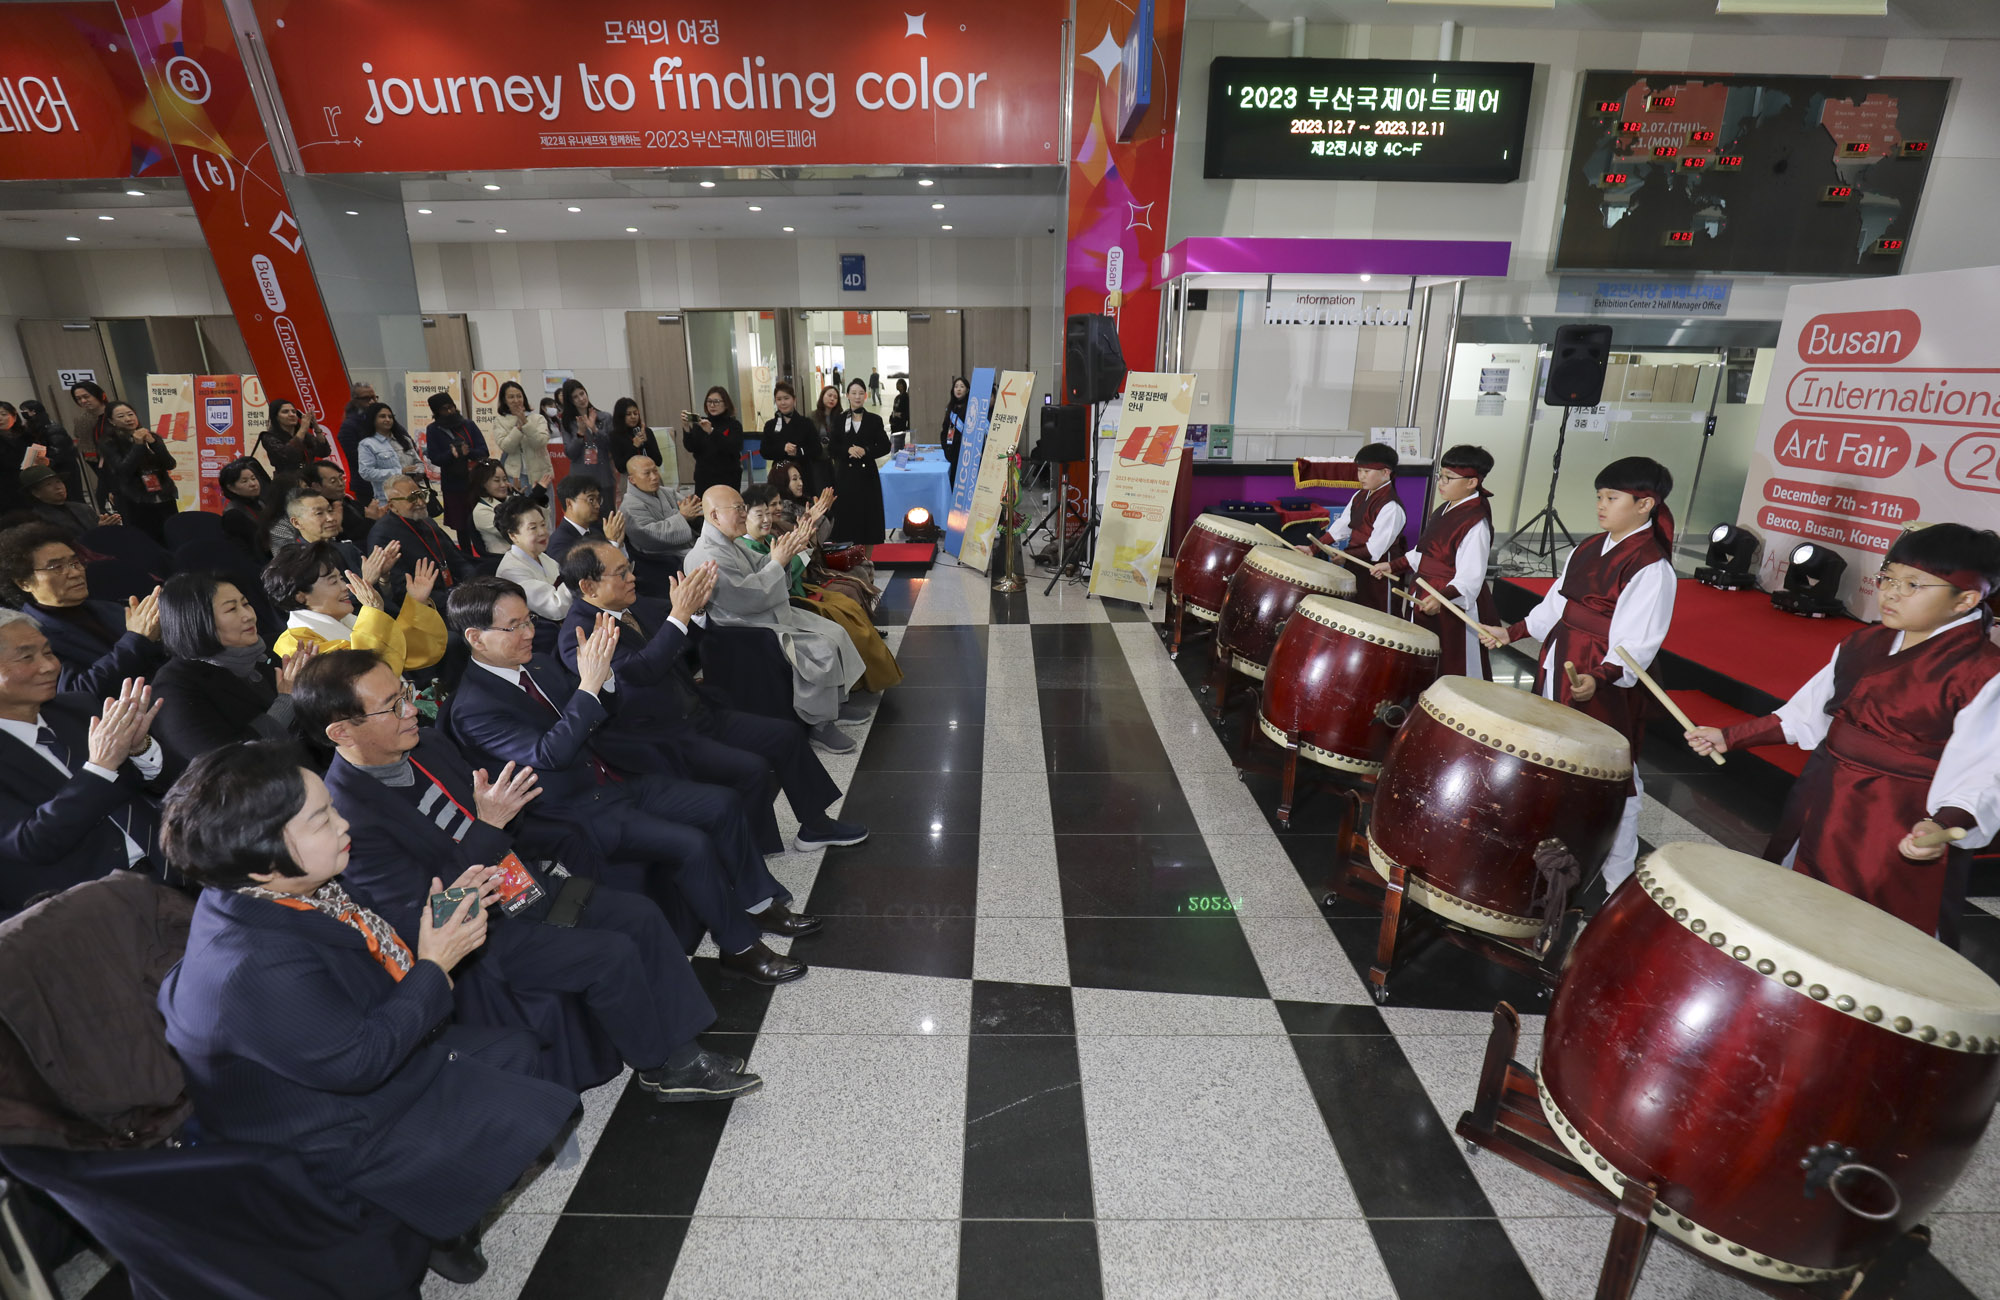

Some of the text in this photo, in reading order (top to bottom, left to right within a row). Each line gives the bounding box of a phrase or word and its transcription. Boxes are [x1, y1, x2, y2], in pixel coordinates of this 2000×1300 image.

[604, 19, 720, 45] 모색의 여정
[365, 55, 988, 124] journey to finding color
[1240, 85, 1500, 113] 2023 부산국제아트페어
[540, 134, 566, 147] 제22회
[567, 133, 608, 147] 유니세프와
[608, 133, 641, 147] 함께하는
[1290, 119, 1356, 135] 2023.12.7
[1374, 120, 1445, 136] 2023.12.11
[1311, 140, 1423, 157] 제2전시장 4C~F
[844, 273, 862, 287] 4D
[1108, 251, 1121, 287] Busan
[255, 260, 279, 306] Busan
[1296, 293, 1356, 305] information
[1594, 298, 1722, 312] Exhibition Center 2 Hall Manager Office
[1807, 324, 1902, 355] Busan
[1128, 402, 1144, 412] 안내
[1130, 390, 1168, 402] 작품집판매
[1780, 428, 1829, 461] Art
[1836, 433, 1898, 468] Fair
[1772, 485, 1832, 507] December
[1834, 493, 1855, 511] 7th
[1870, 501, 1903, 519] 11th
[1766, 512, 1890, 550] Bexco, Busan, Korea
